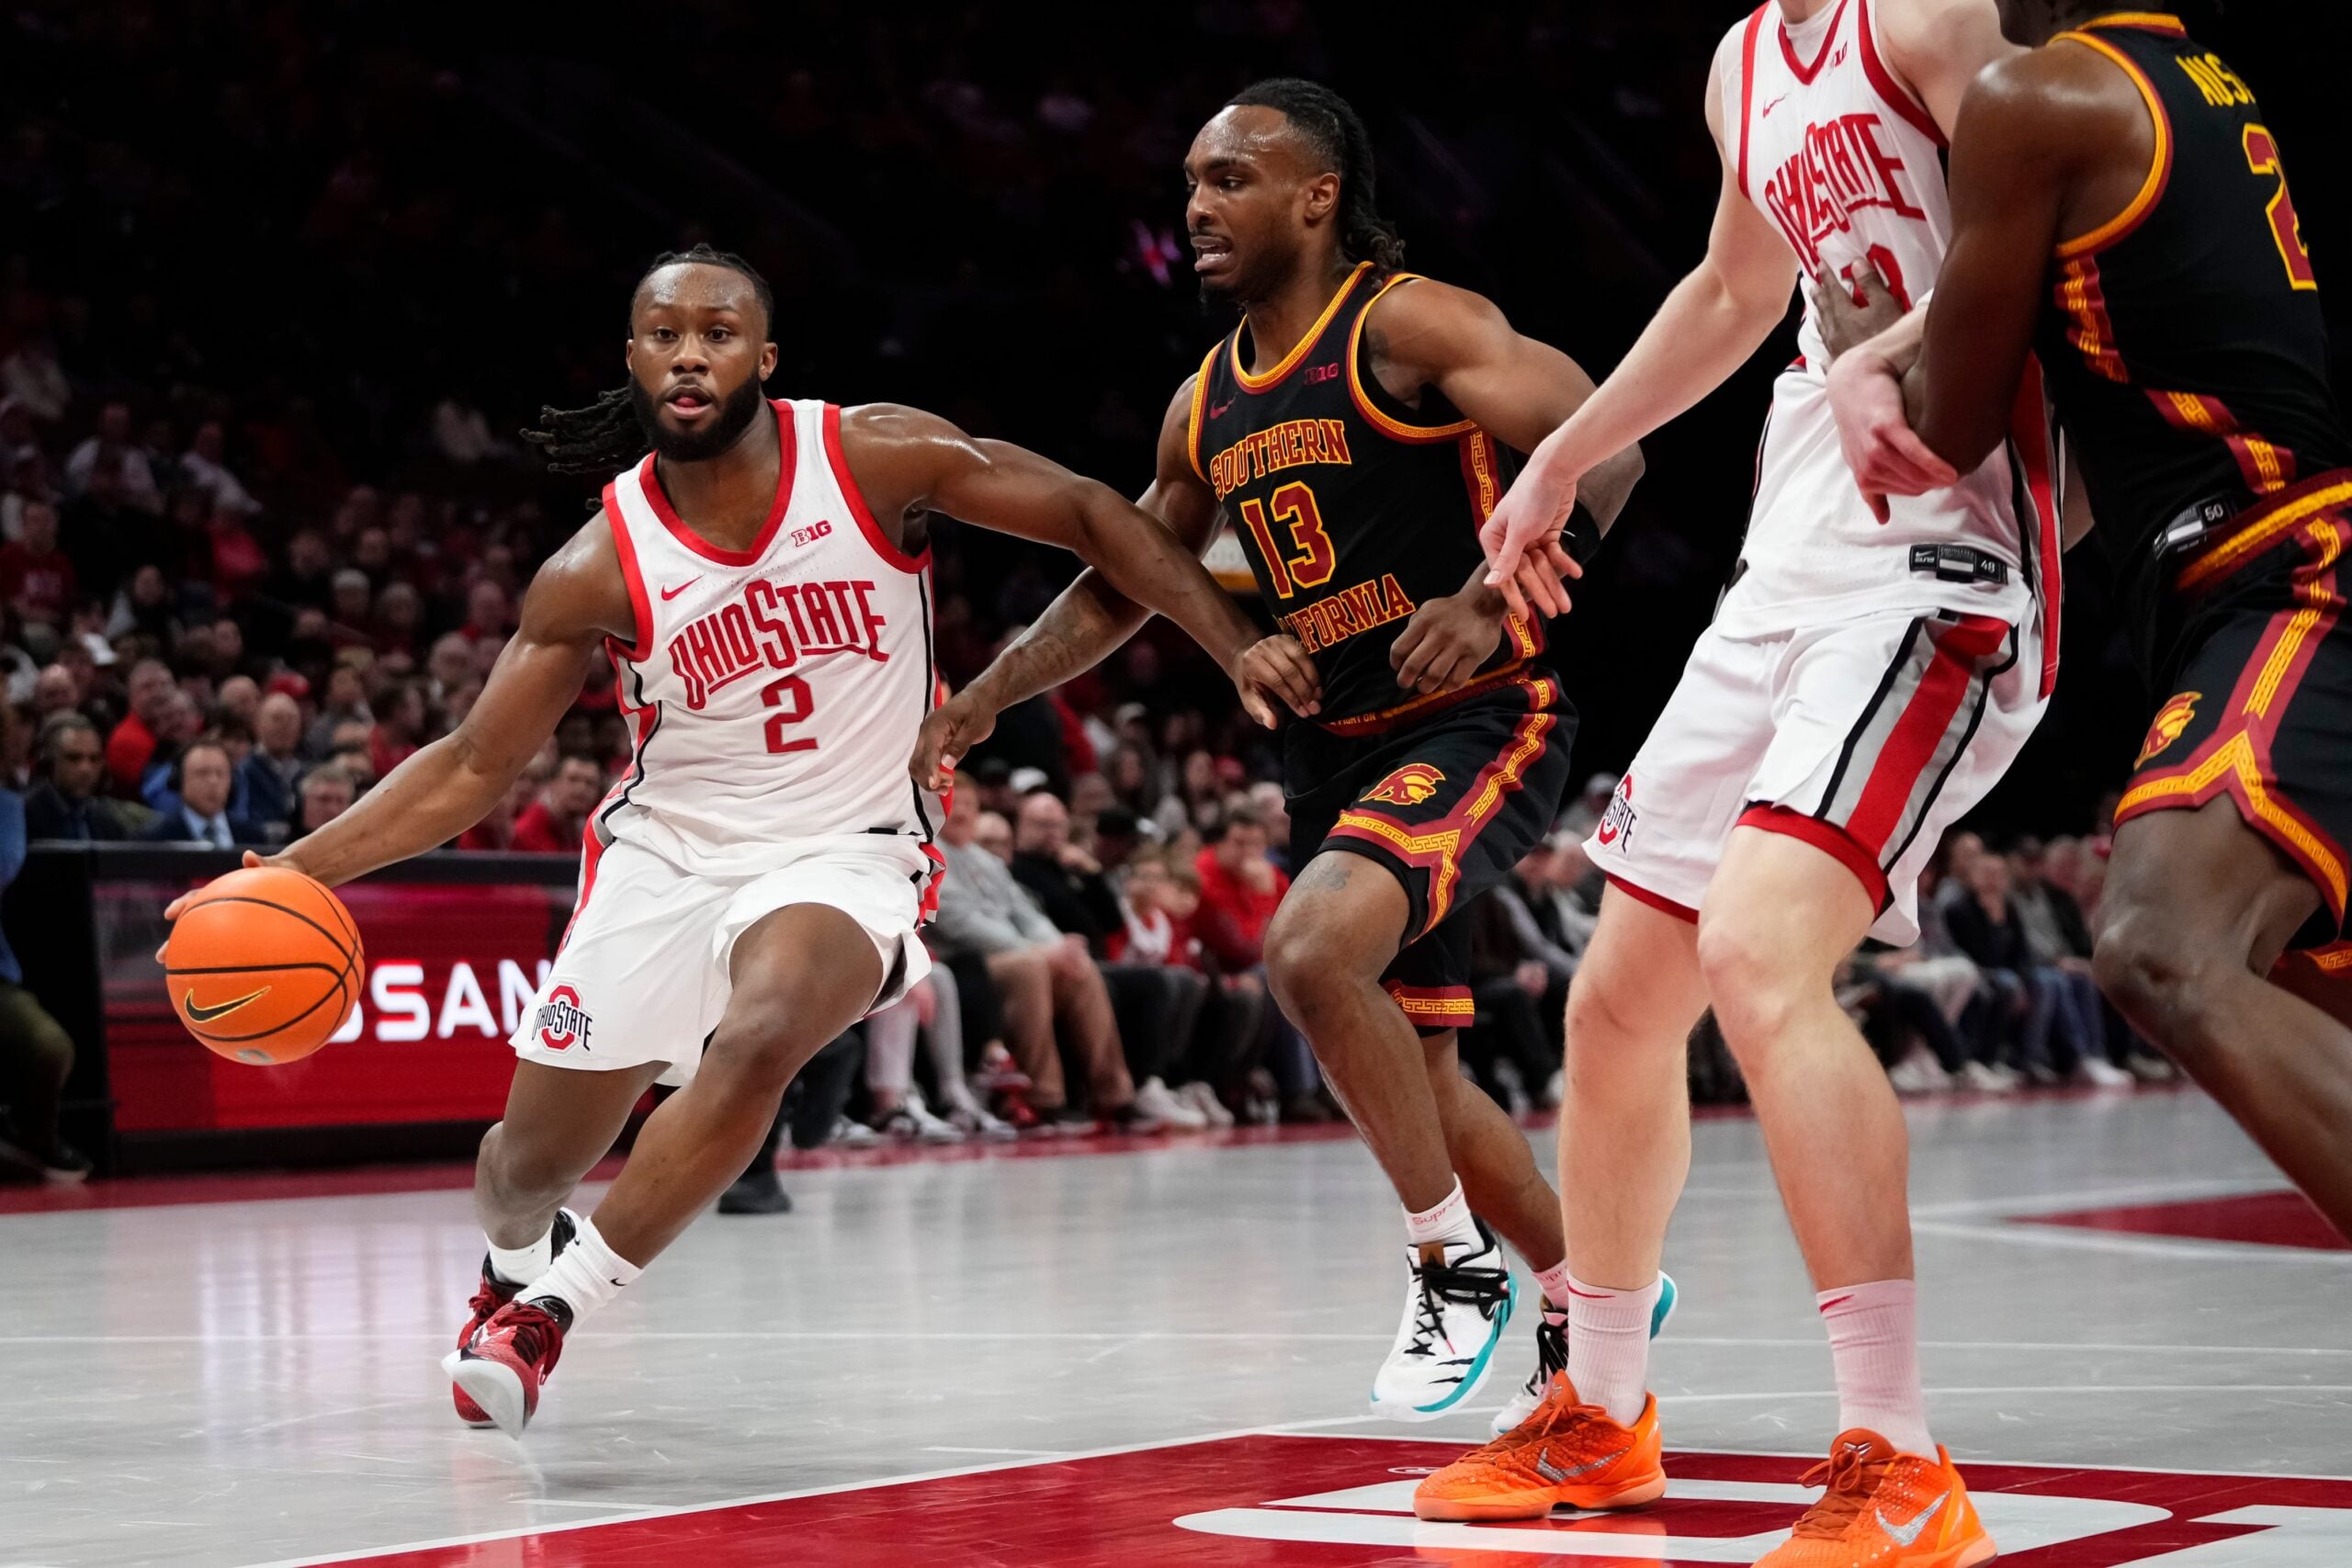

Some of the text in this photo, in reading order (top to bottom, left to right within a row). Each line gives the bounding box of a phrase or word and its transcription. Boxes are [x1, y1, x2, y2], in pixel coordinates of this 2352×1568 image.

[1209, 418, 1352, 502] SOUTHERN
[1239, 480, 1337, 599] 13
[2205, 503, 2223, 522] 50
[1981, 559, 1996, 573] 48
[668, 579, 890, 710] OHIO STATE
[761, 675, 819, 754] 2
